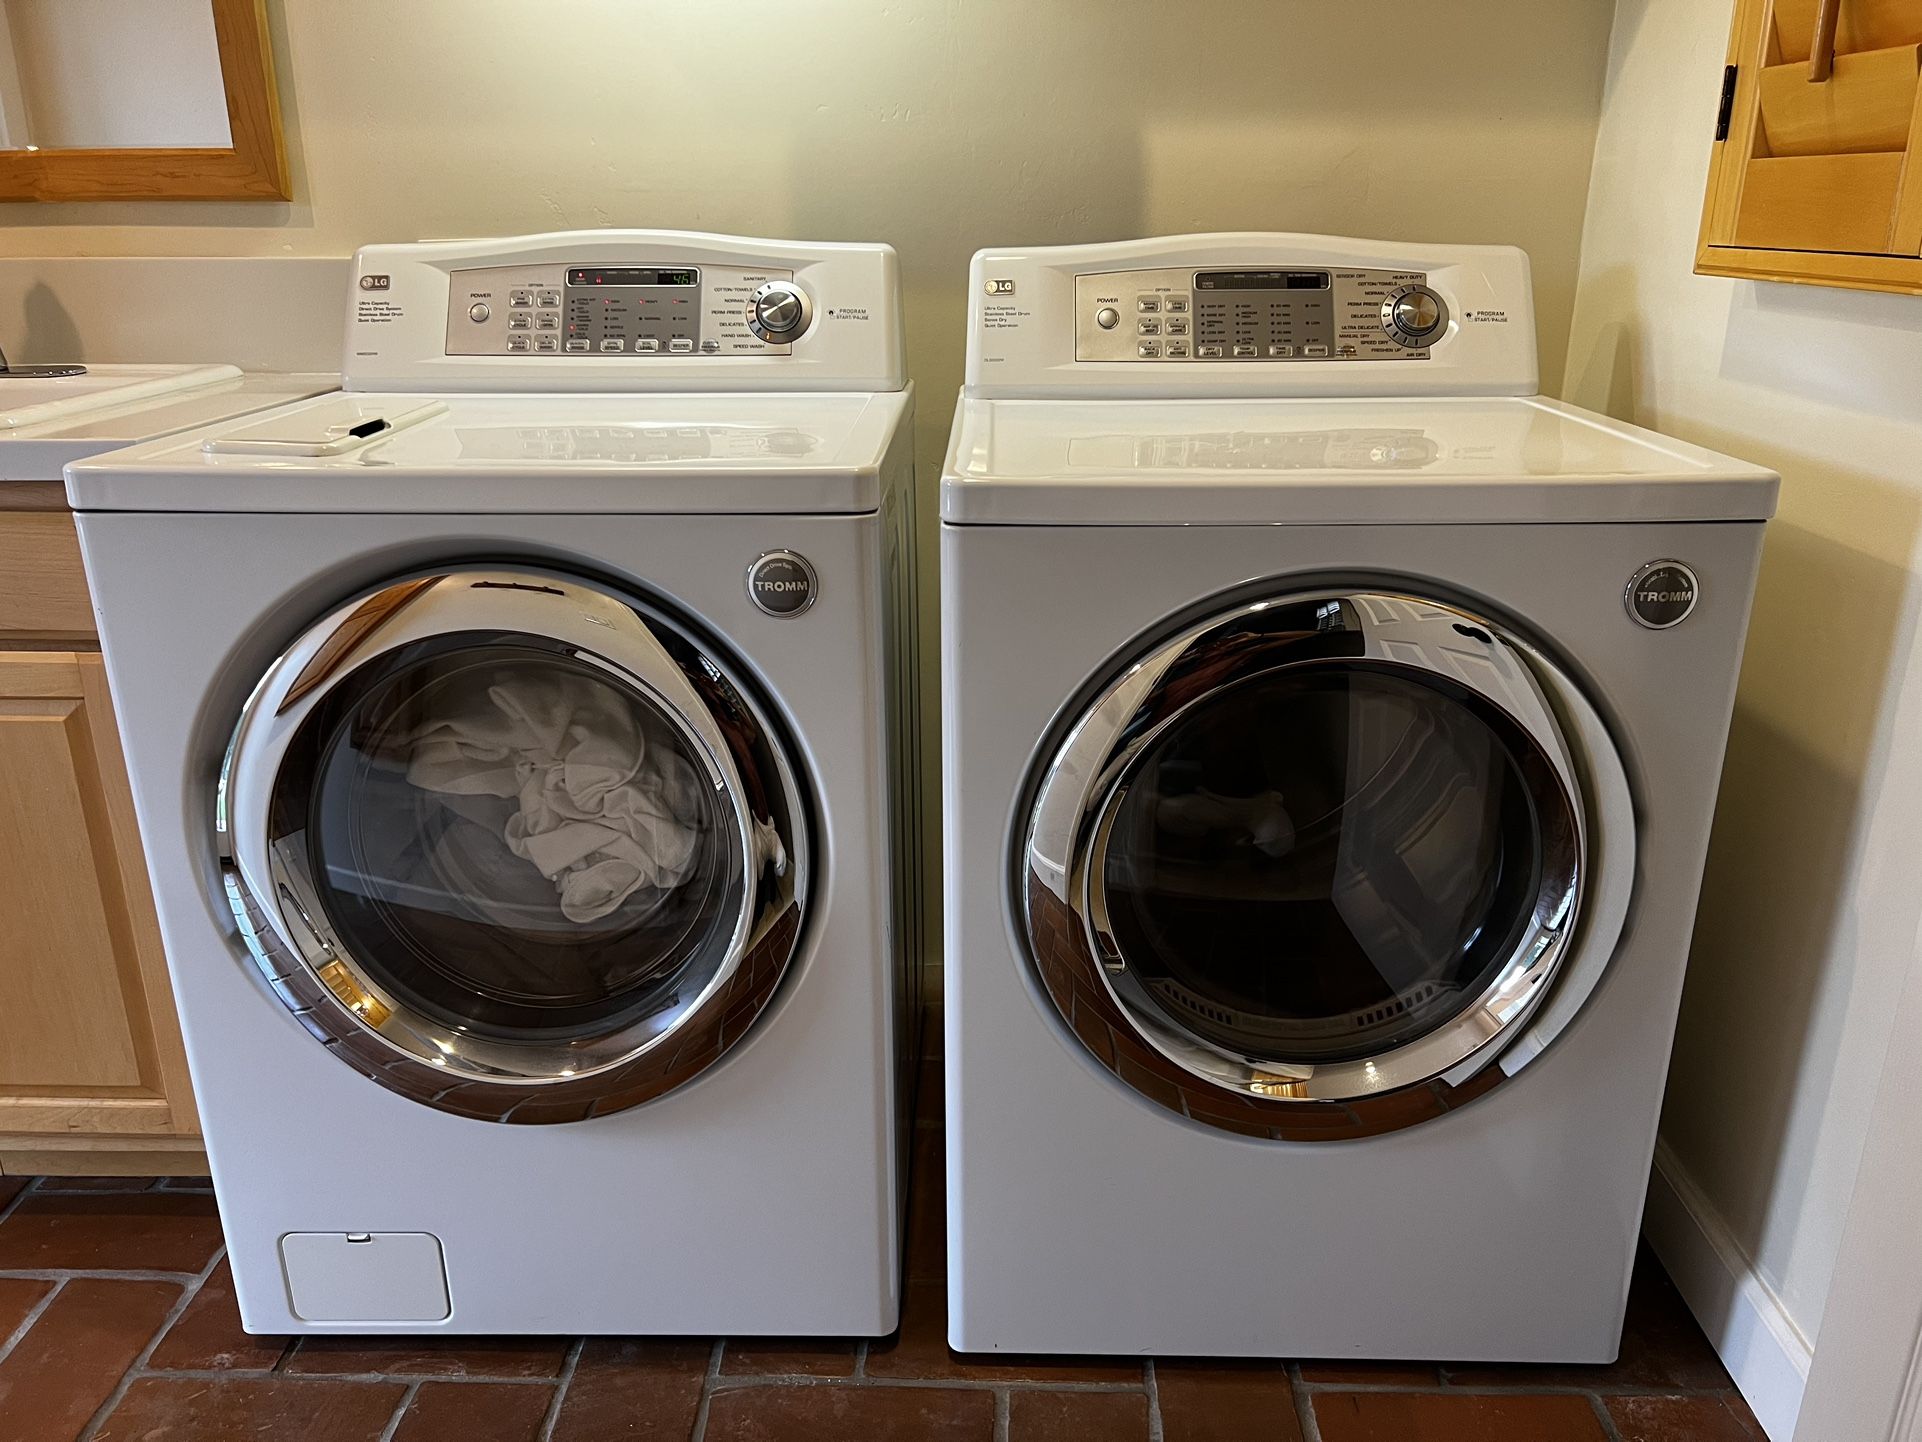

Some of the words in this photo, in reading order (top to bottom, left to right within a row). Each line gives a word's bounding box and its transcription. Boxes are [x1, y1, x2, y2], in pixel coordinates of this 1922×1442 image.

[999, 282, 1012, 290] LG
[755, 581, 808, 592] TROMM
[1638, 591, 1692, 602] TROMM
